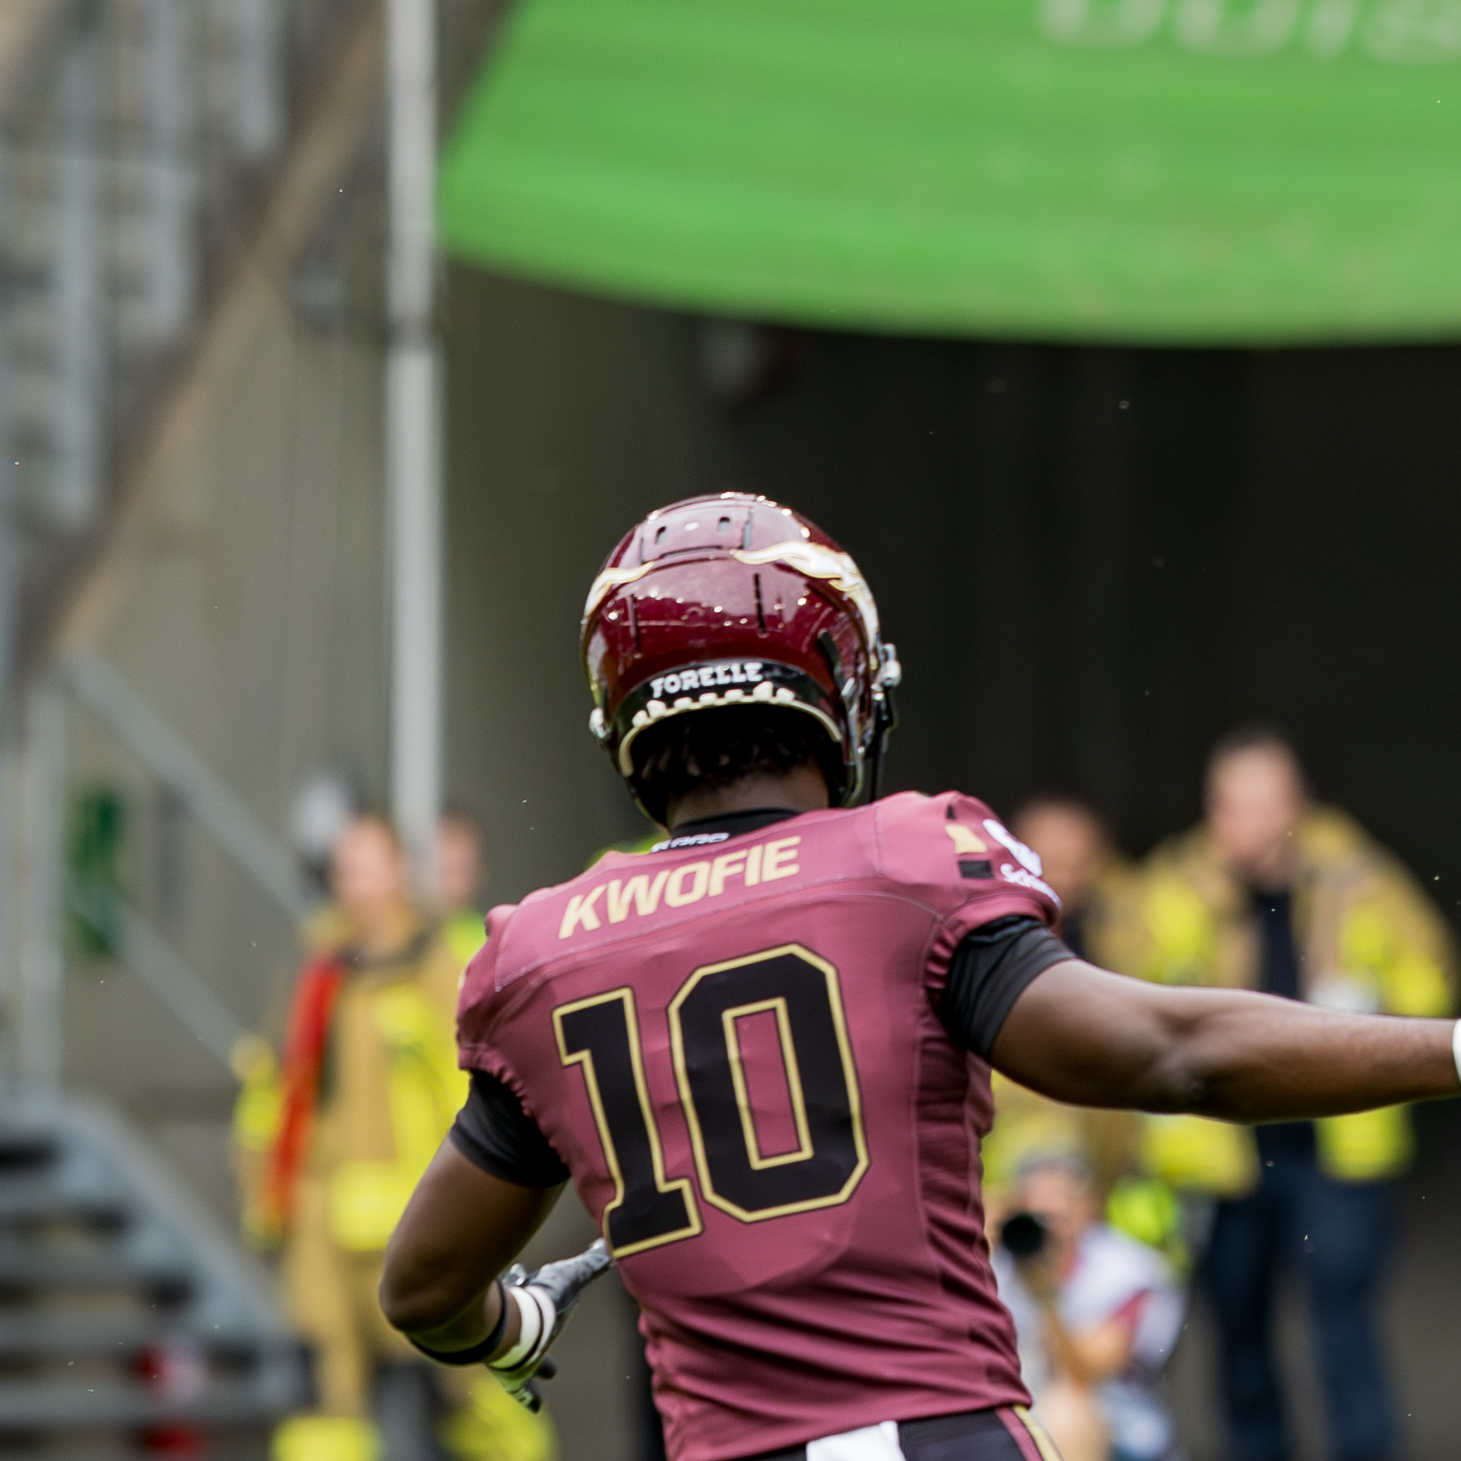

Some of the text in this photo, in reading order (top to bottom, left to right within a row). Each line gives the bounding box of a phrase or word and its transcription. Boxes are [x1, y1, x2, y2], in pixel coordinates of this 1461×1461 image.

[651, 662, 763, 698] FORELLE
[558, 835, 801, 940] KWOFIE
[553, 943, 869, 1257] 10
